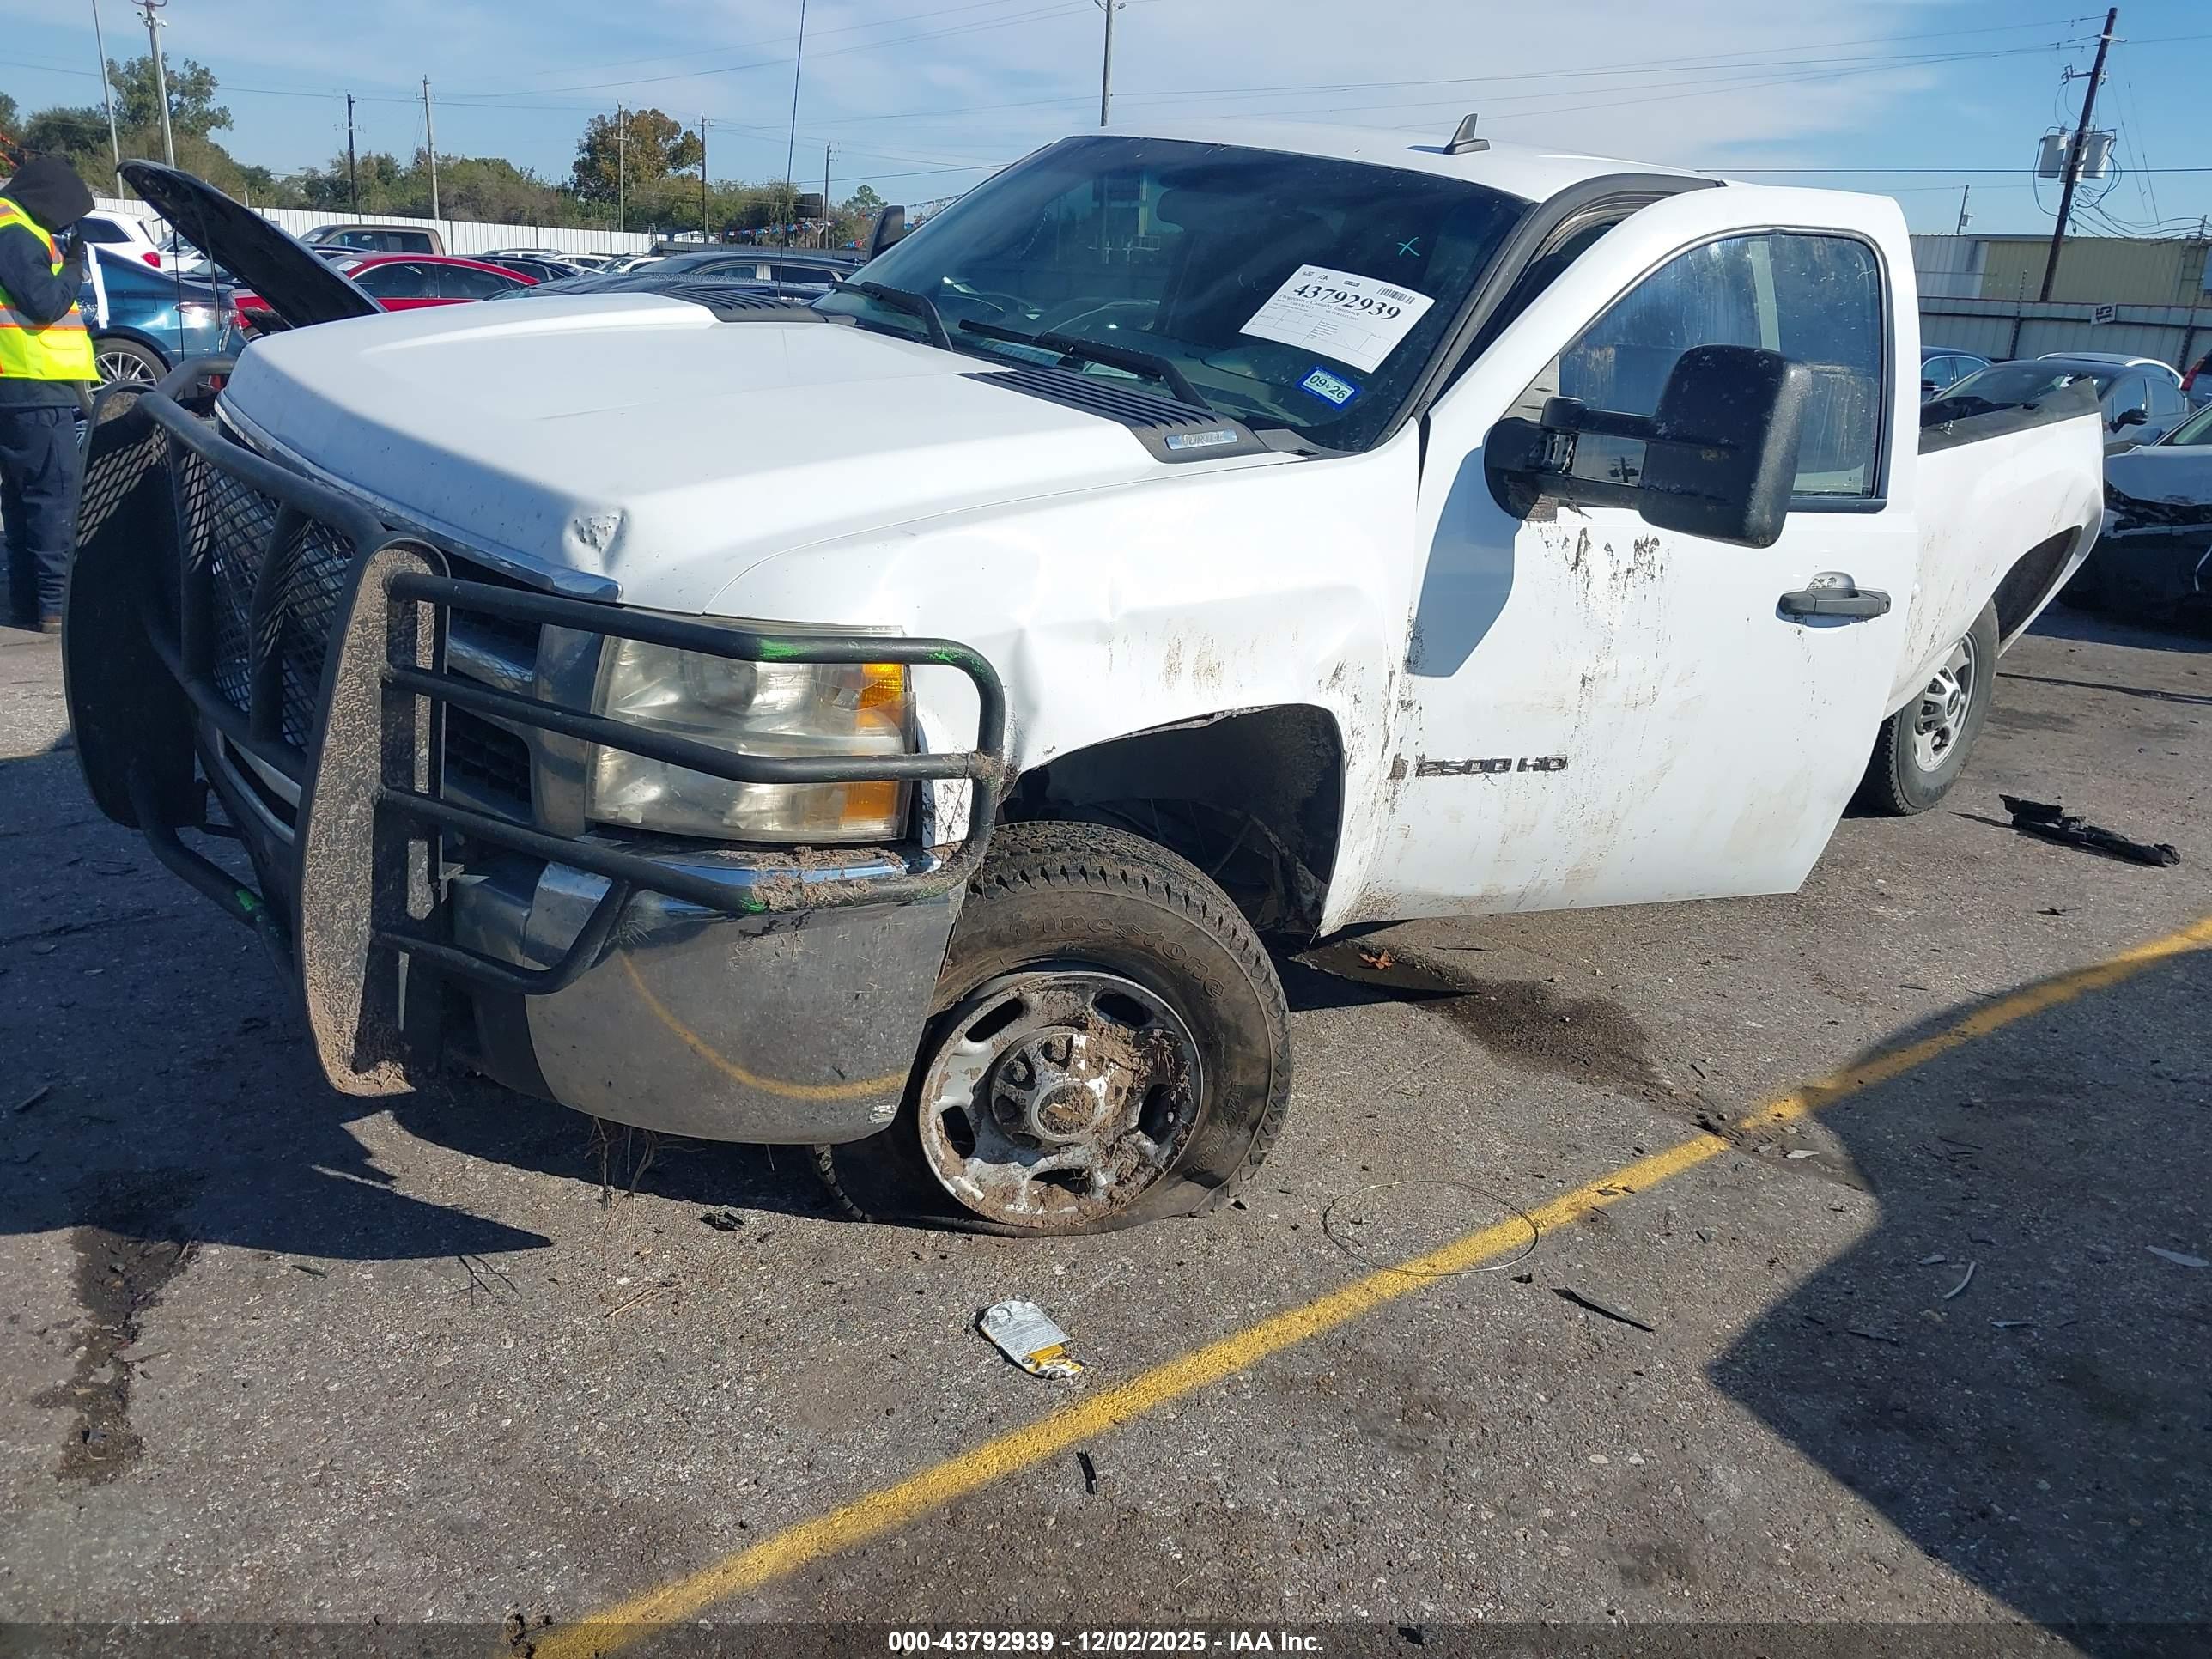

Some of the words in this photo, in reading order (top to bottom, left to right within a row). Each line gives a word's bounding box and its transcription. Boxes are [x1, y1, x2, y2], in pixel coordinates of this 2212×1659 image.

[1293, 283, 1401, 319] 43792939
[1309, 375, 1328, 387] 09
[1328, 386, 1348, 399] 26
[1415, 757, 1514, 777] 2500
[1516, 755, 1569, 772] HD
